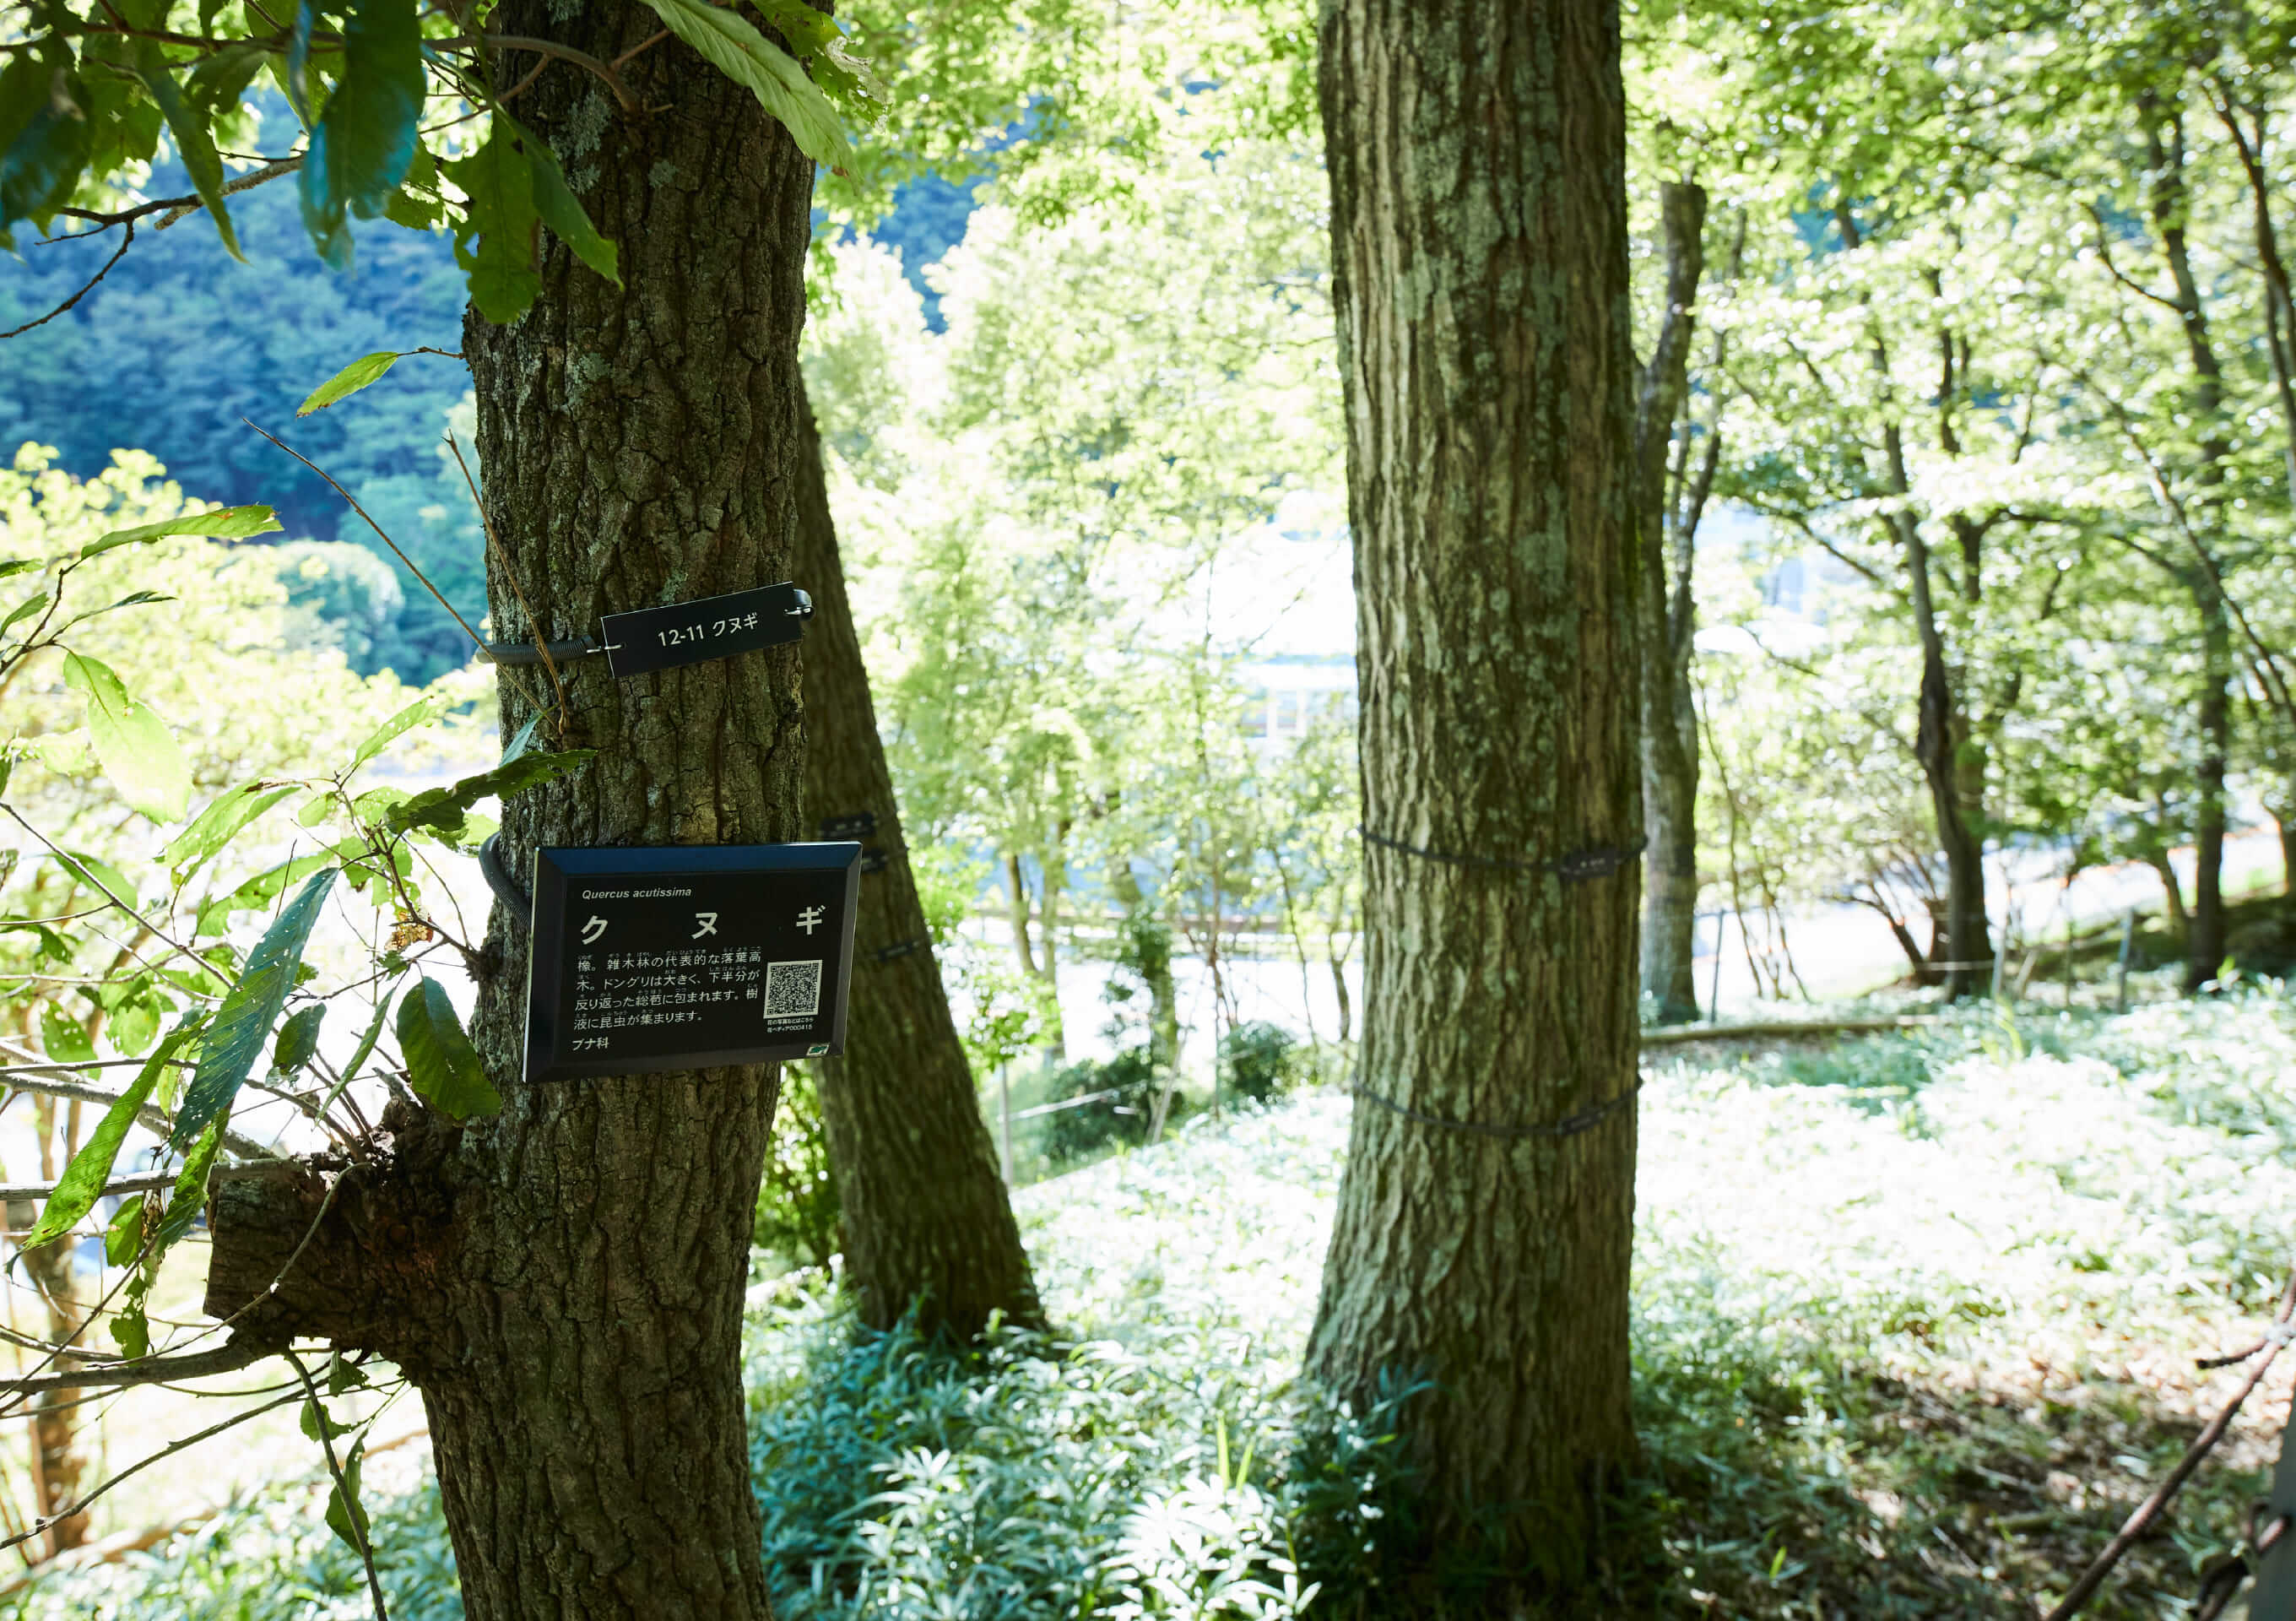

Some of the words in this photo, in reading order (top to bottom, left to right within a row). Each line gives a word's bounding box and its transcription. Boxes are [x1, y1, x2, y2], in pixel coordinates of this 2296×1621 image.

[658, 624, 705, 647] 12-11
[712, 611, 759, 637] クヌギ
[582, 889, 630, 900] Quercus
[632, 886, 692, 898] acutissima
[573, 1011, 702, 1031] 液に昆虫が集まります。
[571, 1036, 609, 1050] ブナ科
